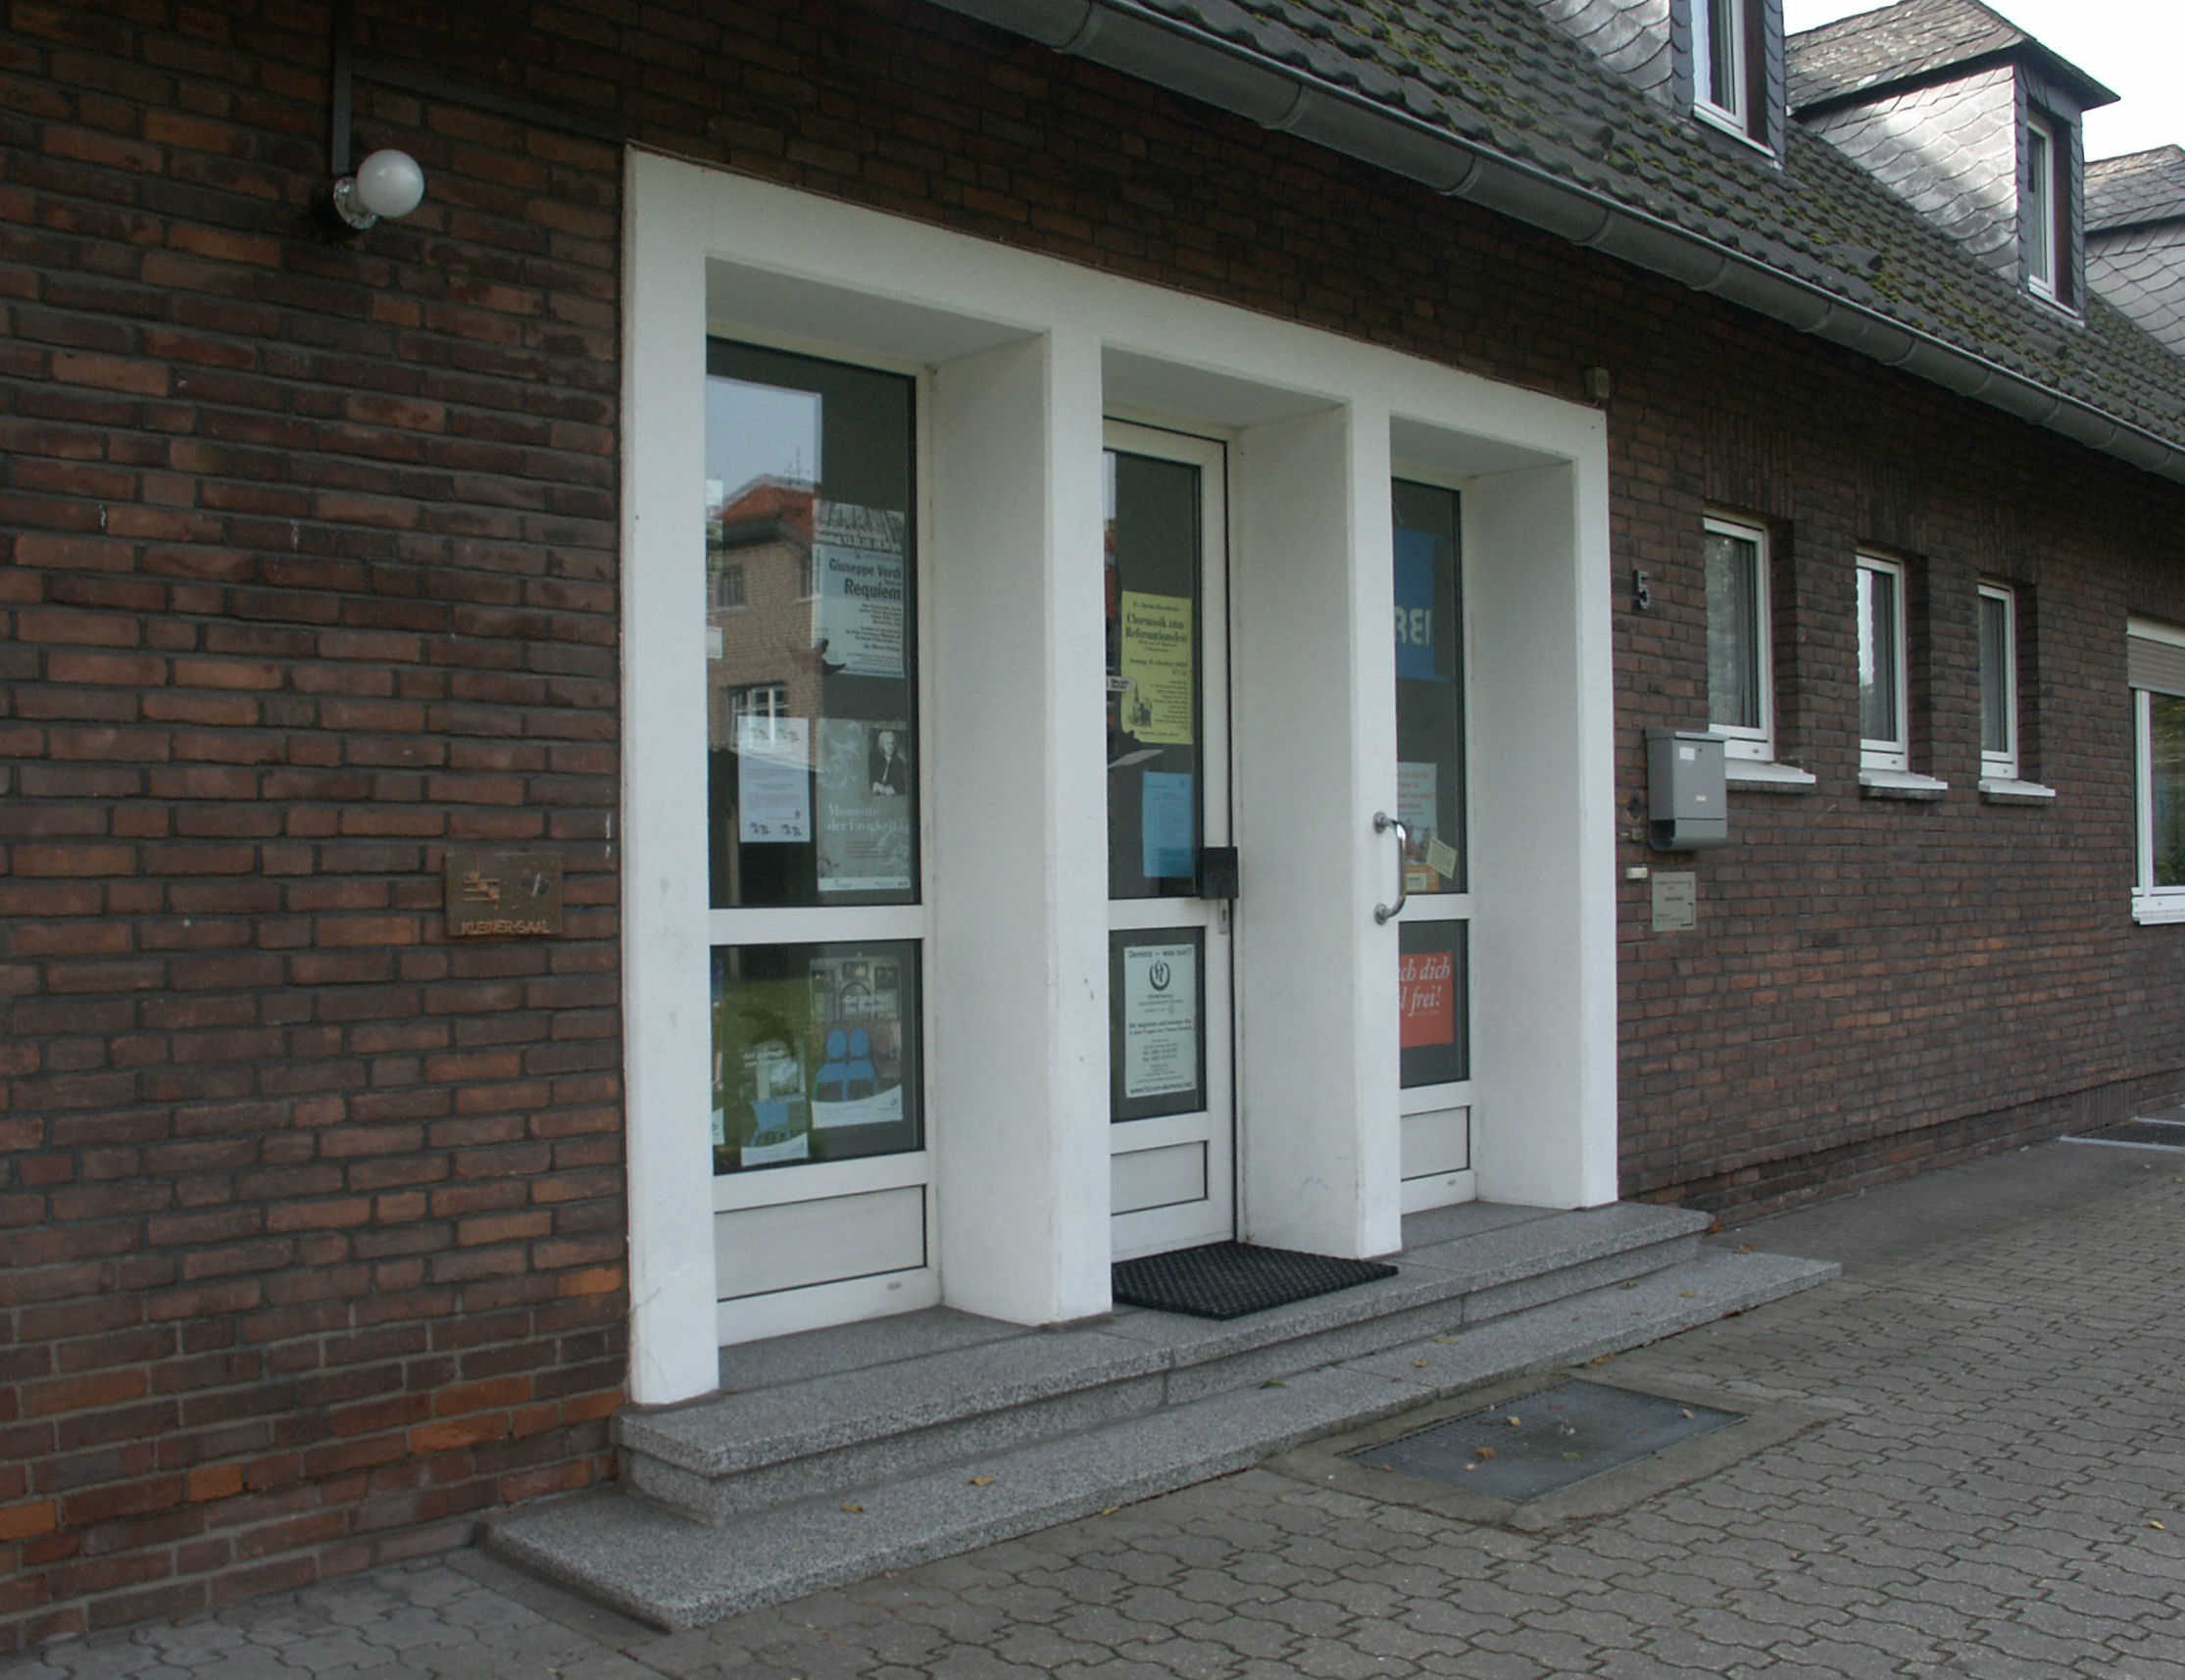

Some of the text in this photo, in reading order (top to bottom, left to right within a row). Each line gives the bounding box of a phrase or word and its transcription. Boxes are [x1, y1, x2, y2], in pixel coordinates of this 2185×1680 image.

[828, 558, 902, 580] Giuseppe Verdi
[844, 577, 902, 601] Requiem
[1637, 570, 1651, 610] 5
[1408, 985, 1442, 1016] frei!
